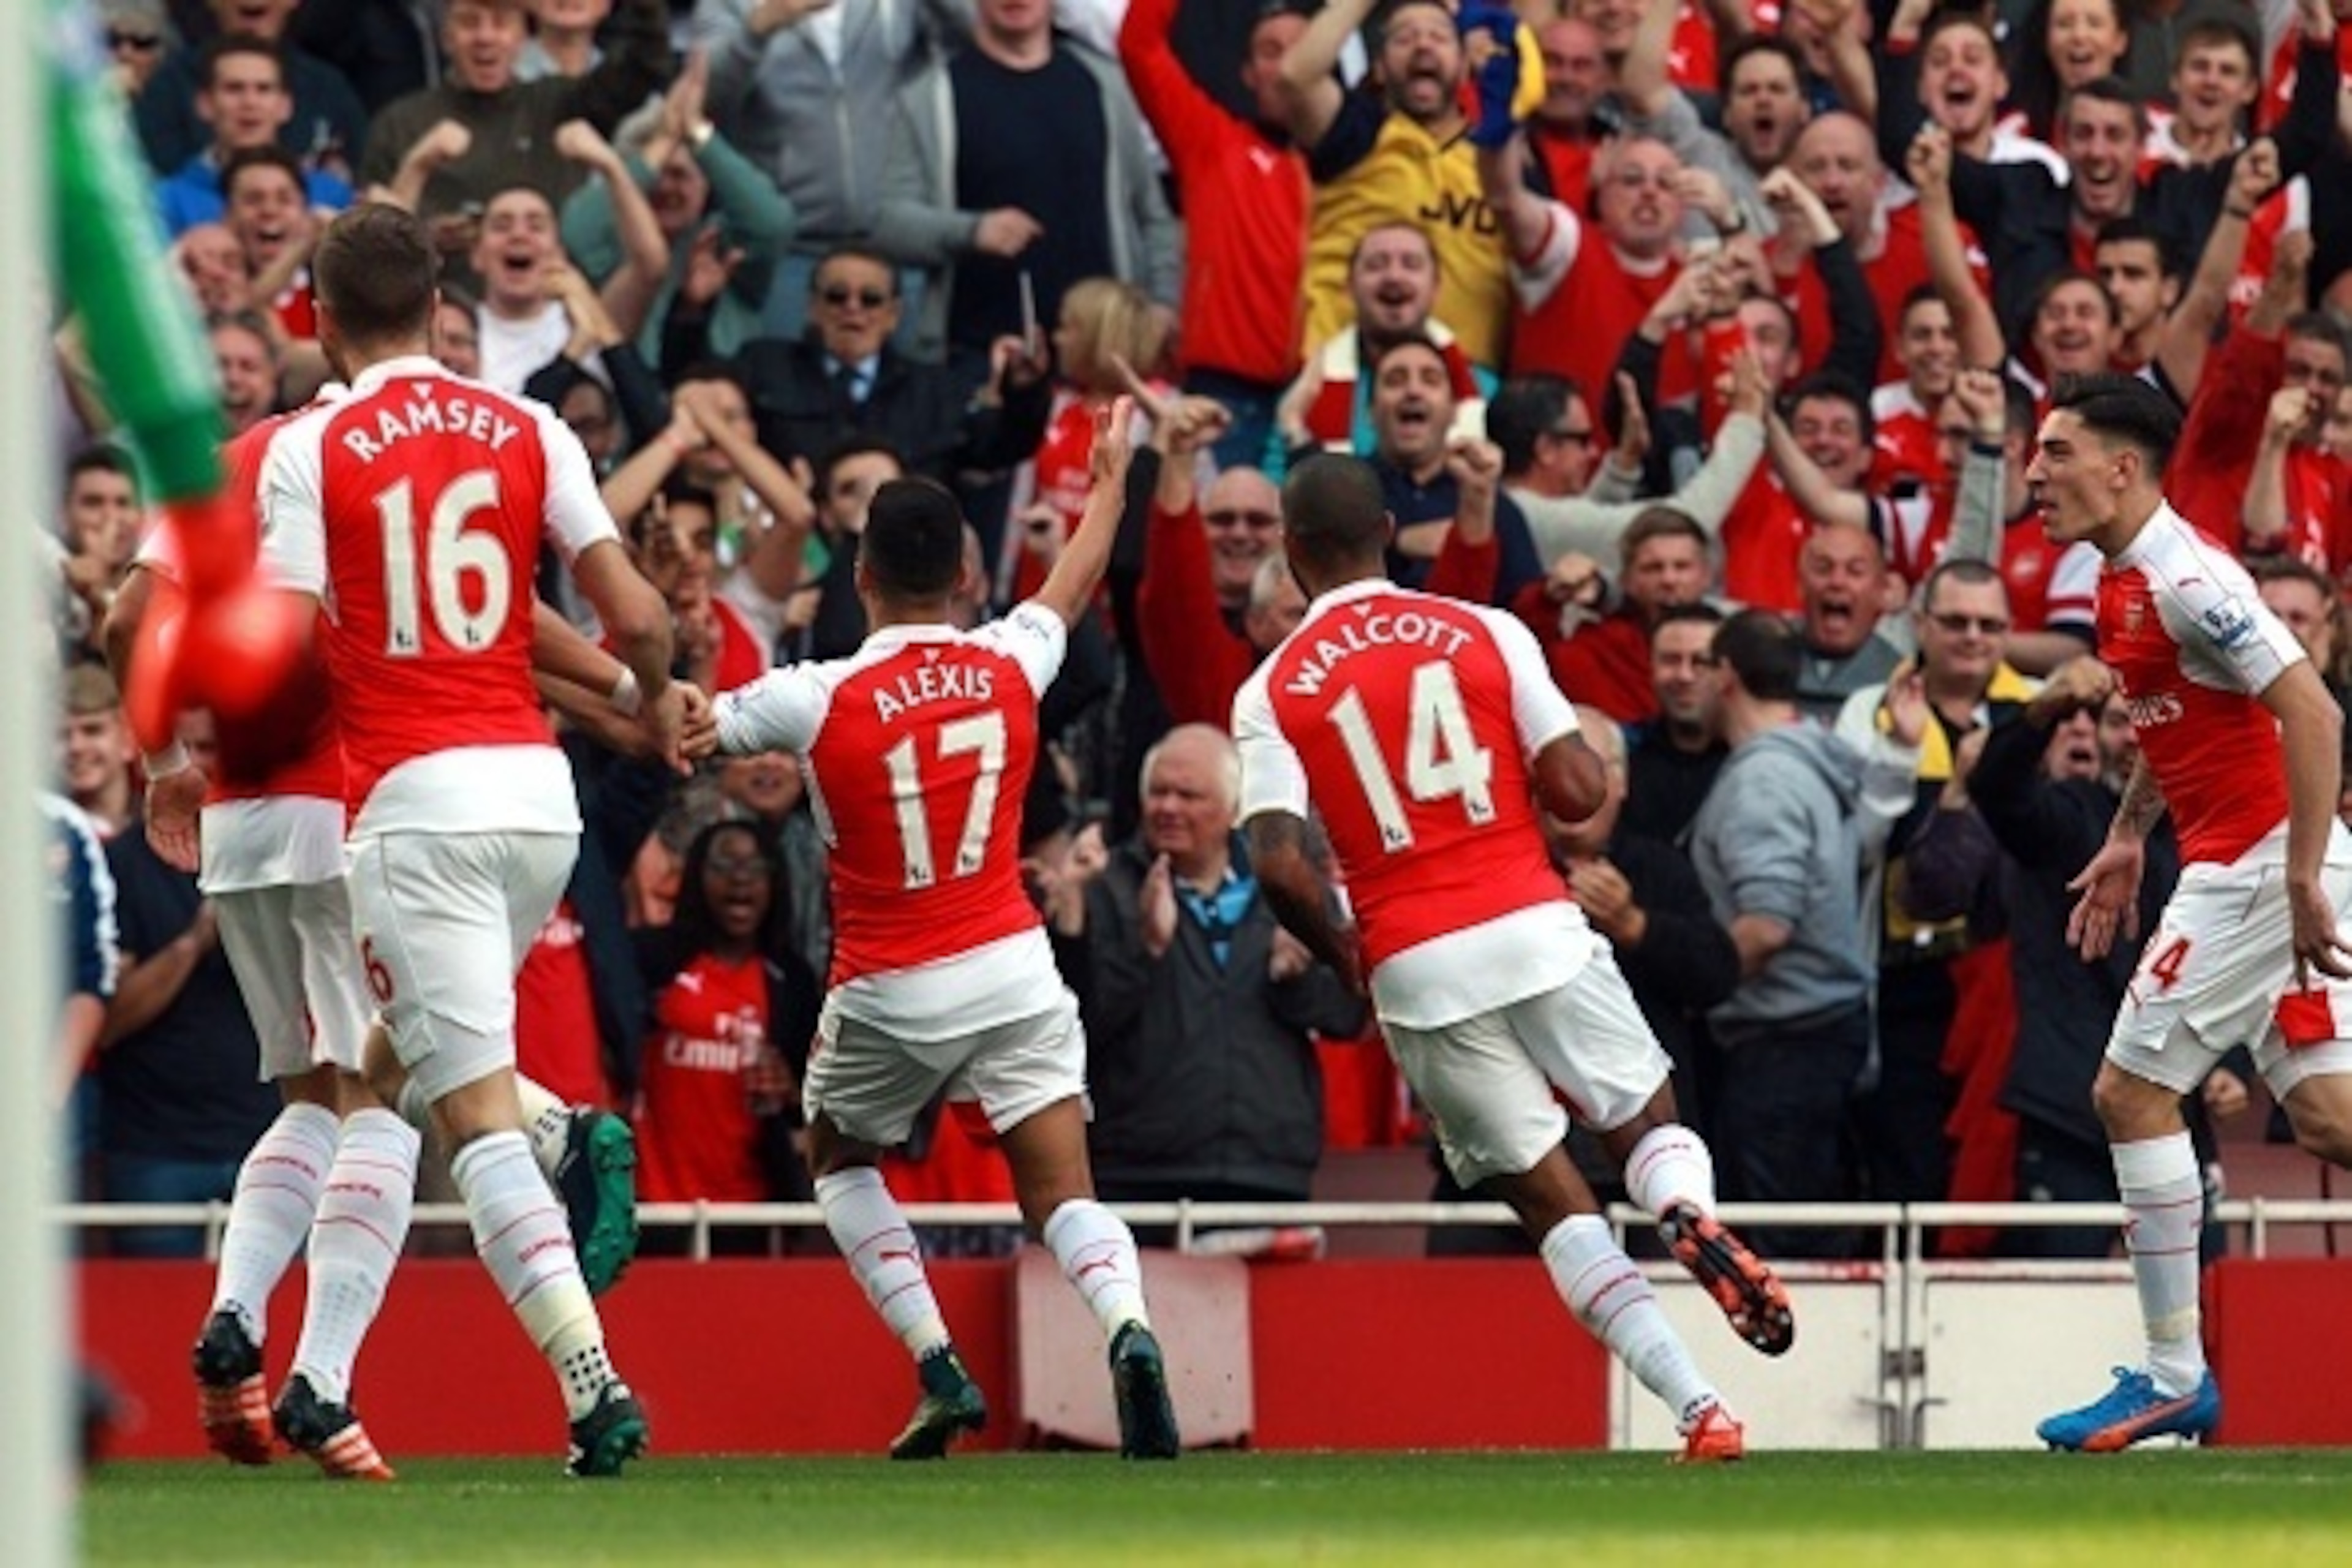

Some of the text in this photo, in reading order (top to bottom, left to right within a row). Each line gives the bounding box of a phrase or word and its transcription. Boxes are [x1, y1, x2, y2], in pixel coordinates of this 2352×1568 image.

[342, 398, 520, 464] RAMSEY
[372, 469, 512, 658] 16
[873, 664, 993, 723] ALEXIS
[1285, 612, 1474, 696] WALCOTT
[883, 709, 1008, 890] 17
[1325, 658, 1498, 854] 14
